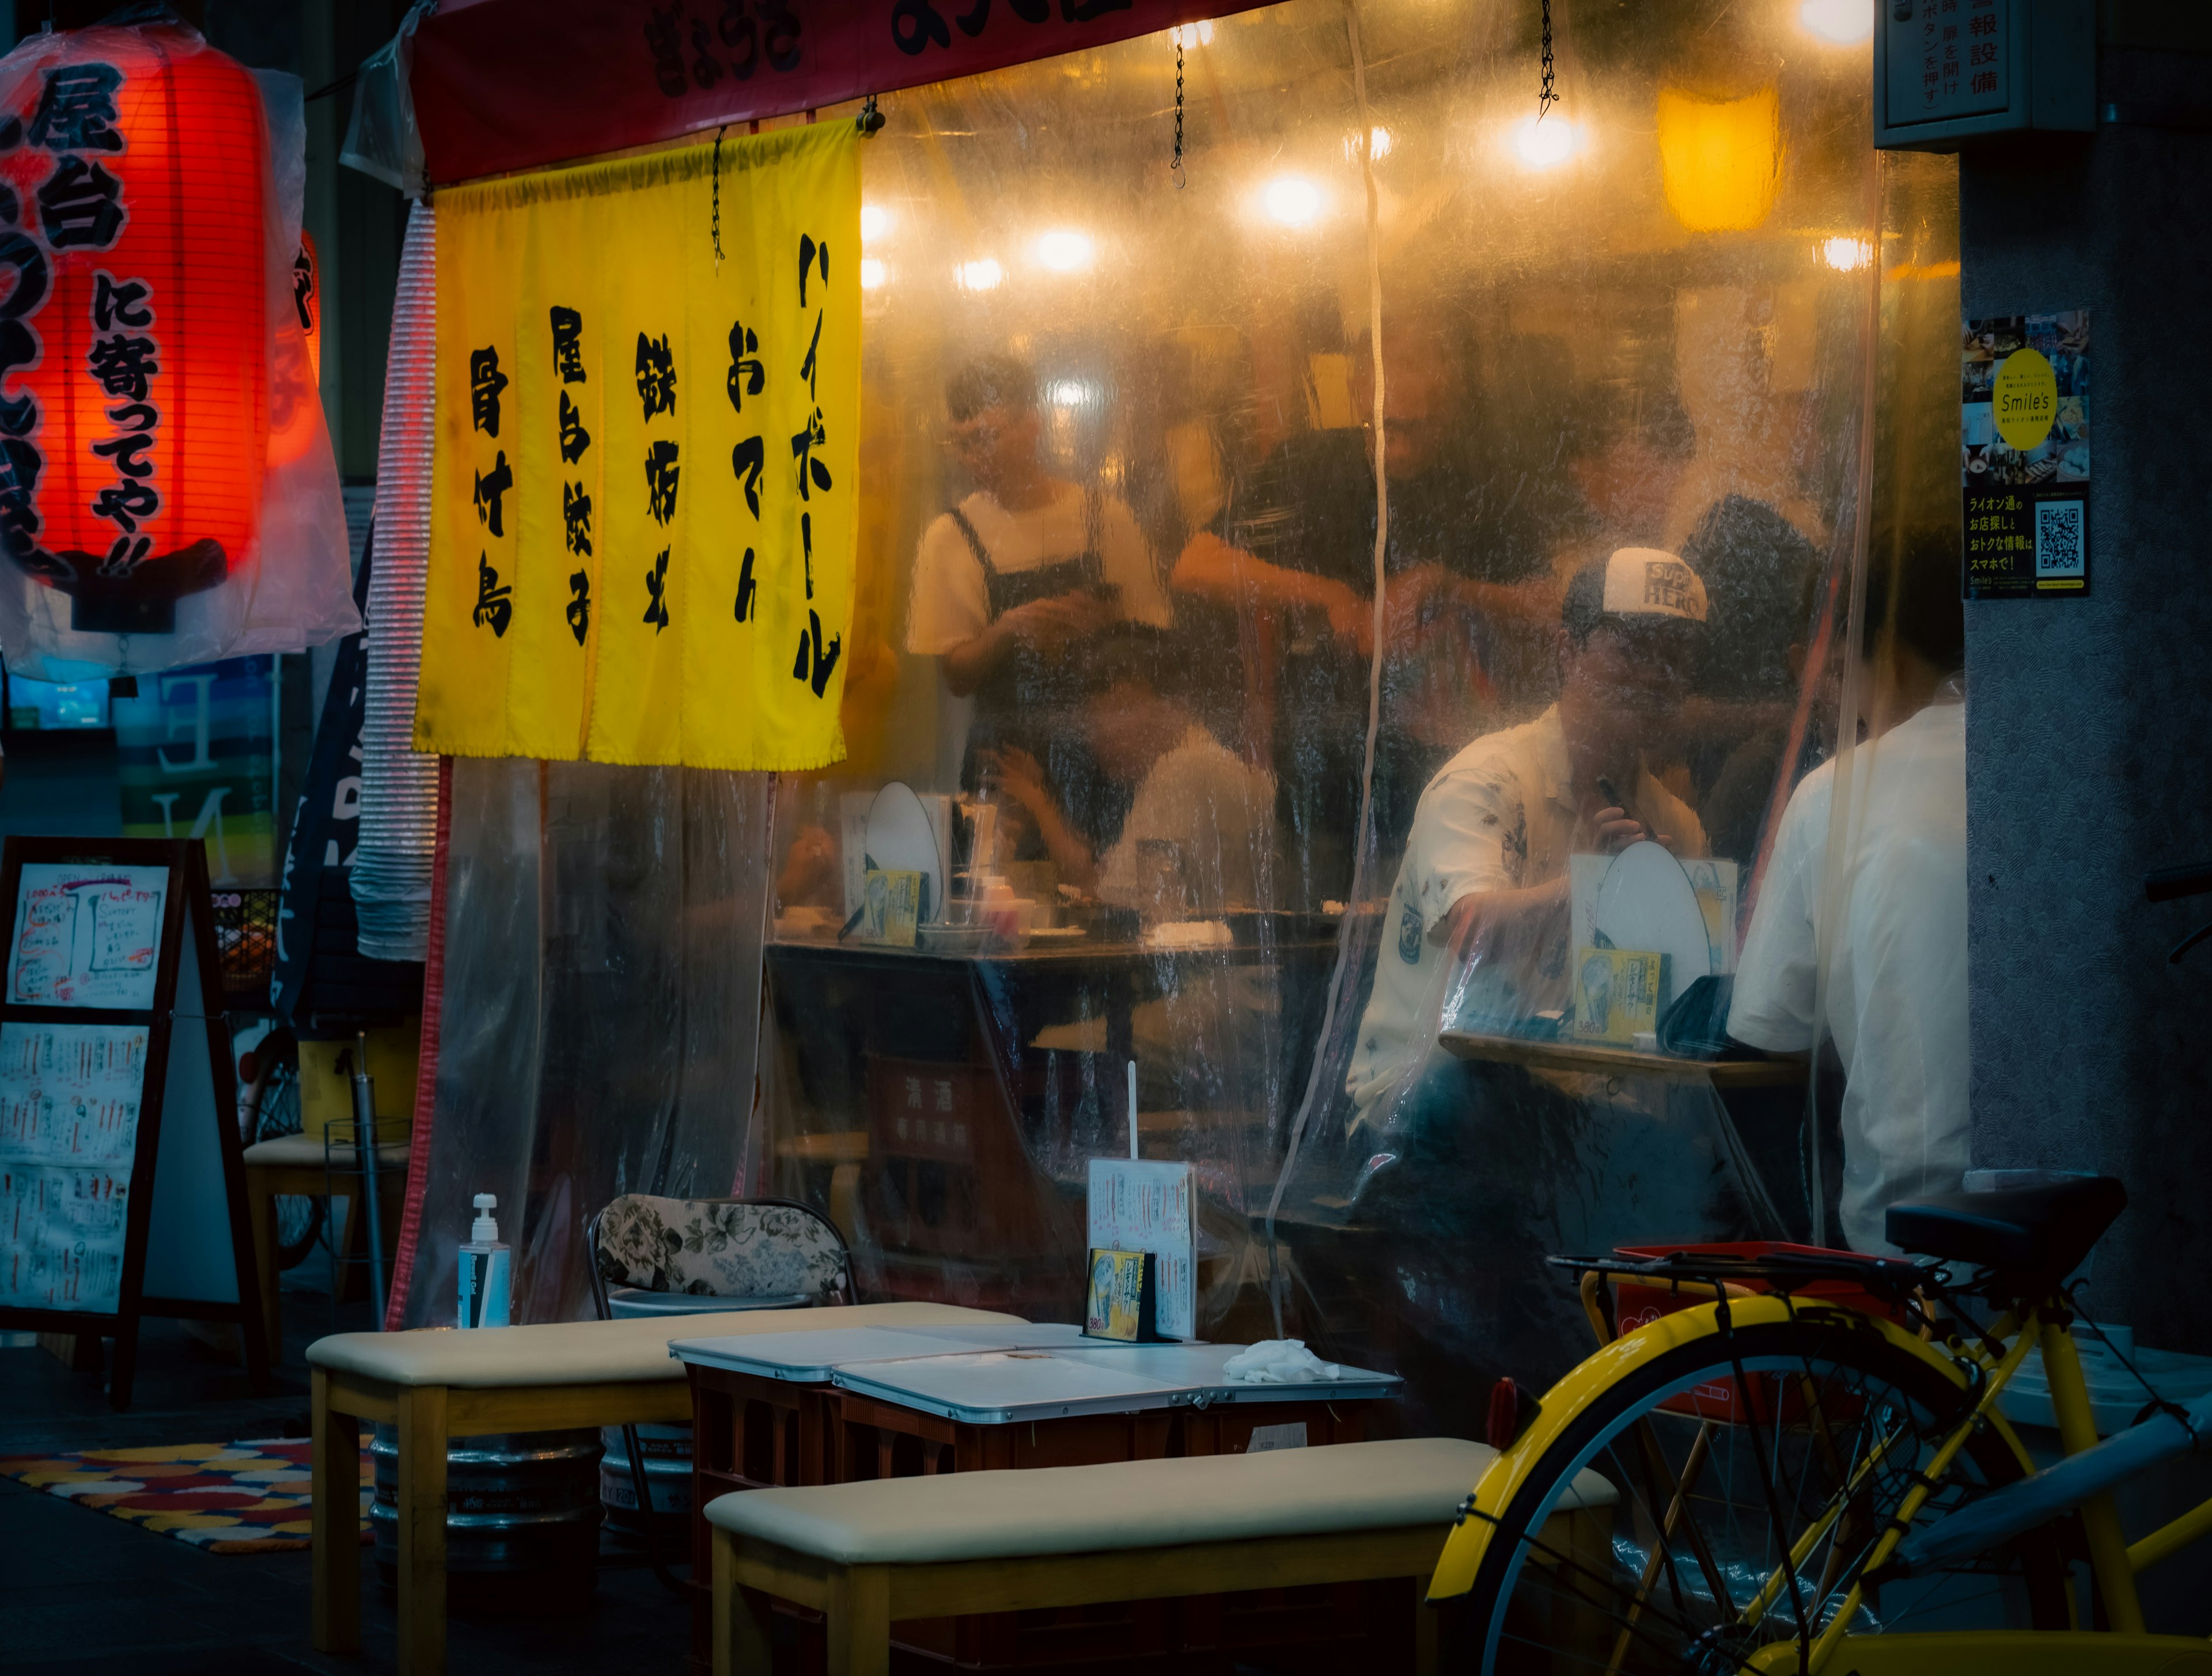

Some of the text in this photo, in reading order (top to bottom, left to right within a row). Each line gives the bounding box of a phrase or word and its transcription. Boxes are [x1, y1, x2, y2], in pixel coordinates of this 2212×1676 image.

[1923, 0, 1939, 109] ボタンを押す)
[1942, 25, 1959, 95] 扉を開け
[1969, 0, 1998, 94] 報設備
[2002, 392, 2049, 411] Smile's
[793, 233, 840, 699] ハイボール
[470, 345, 513, 638] 骨付鳥
[1969, 495, 2023, 512] ライオン通の
[1969, 515, 2015, 531] お店探しと
[1969, 535, 2032, 552] おトクな情報は
[1970, 576, 1992, 585] Smile's
